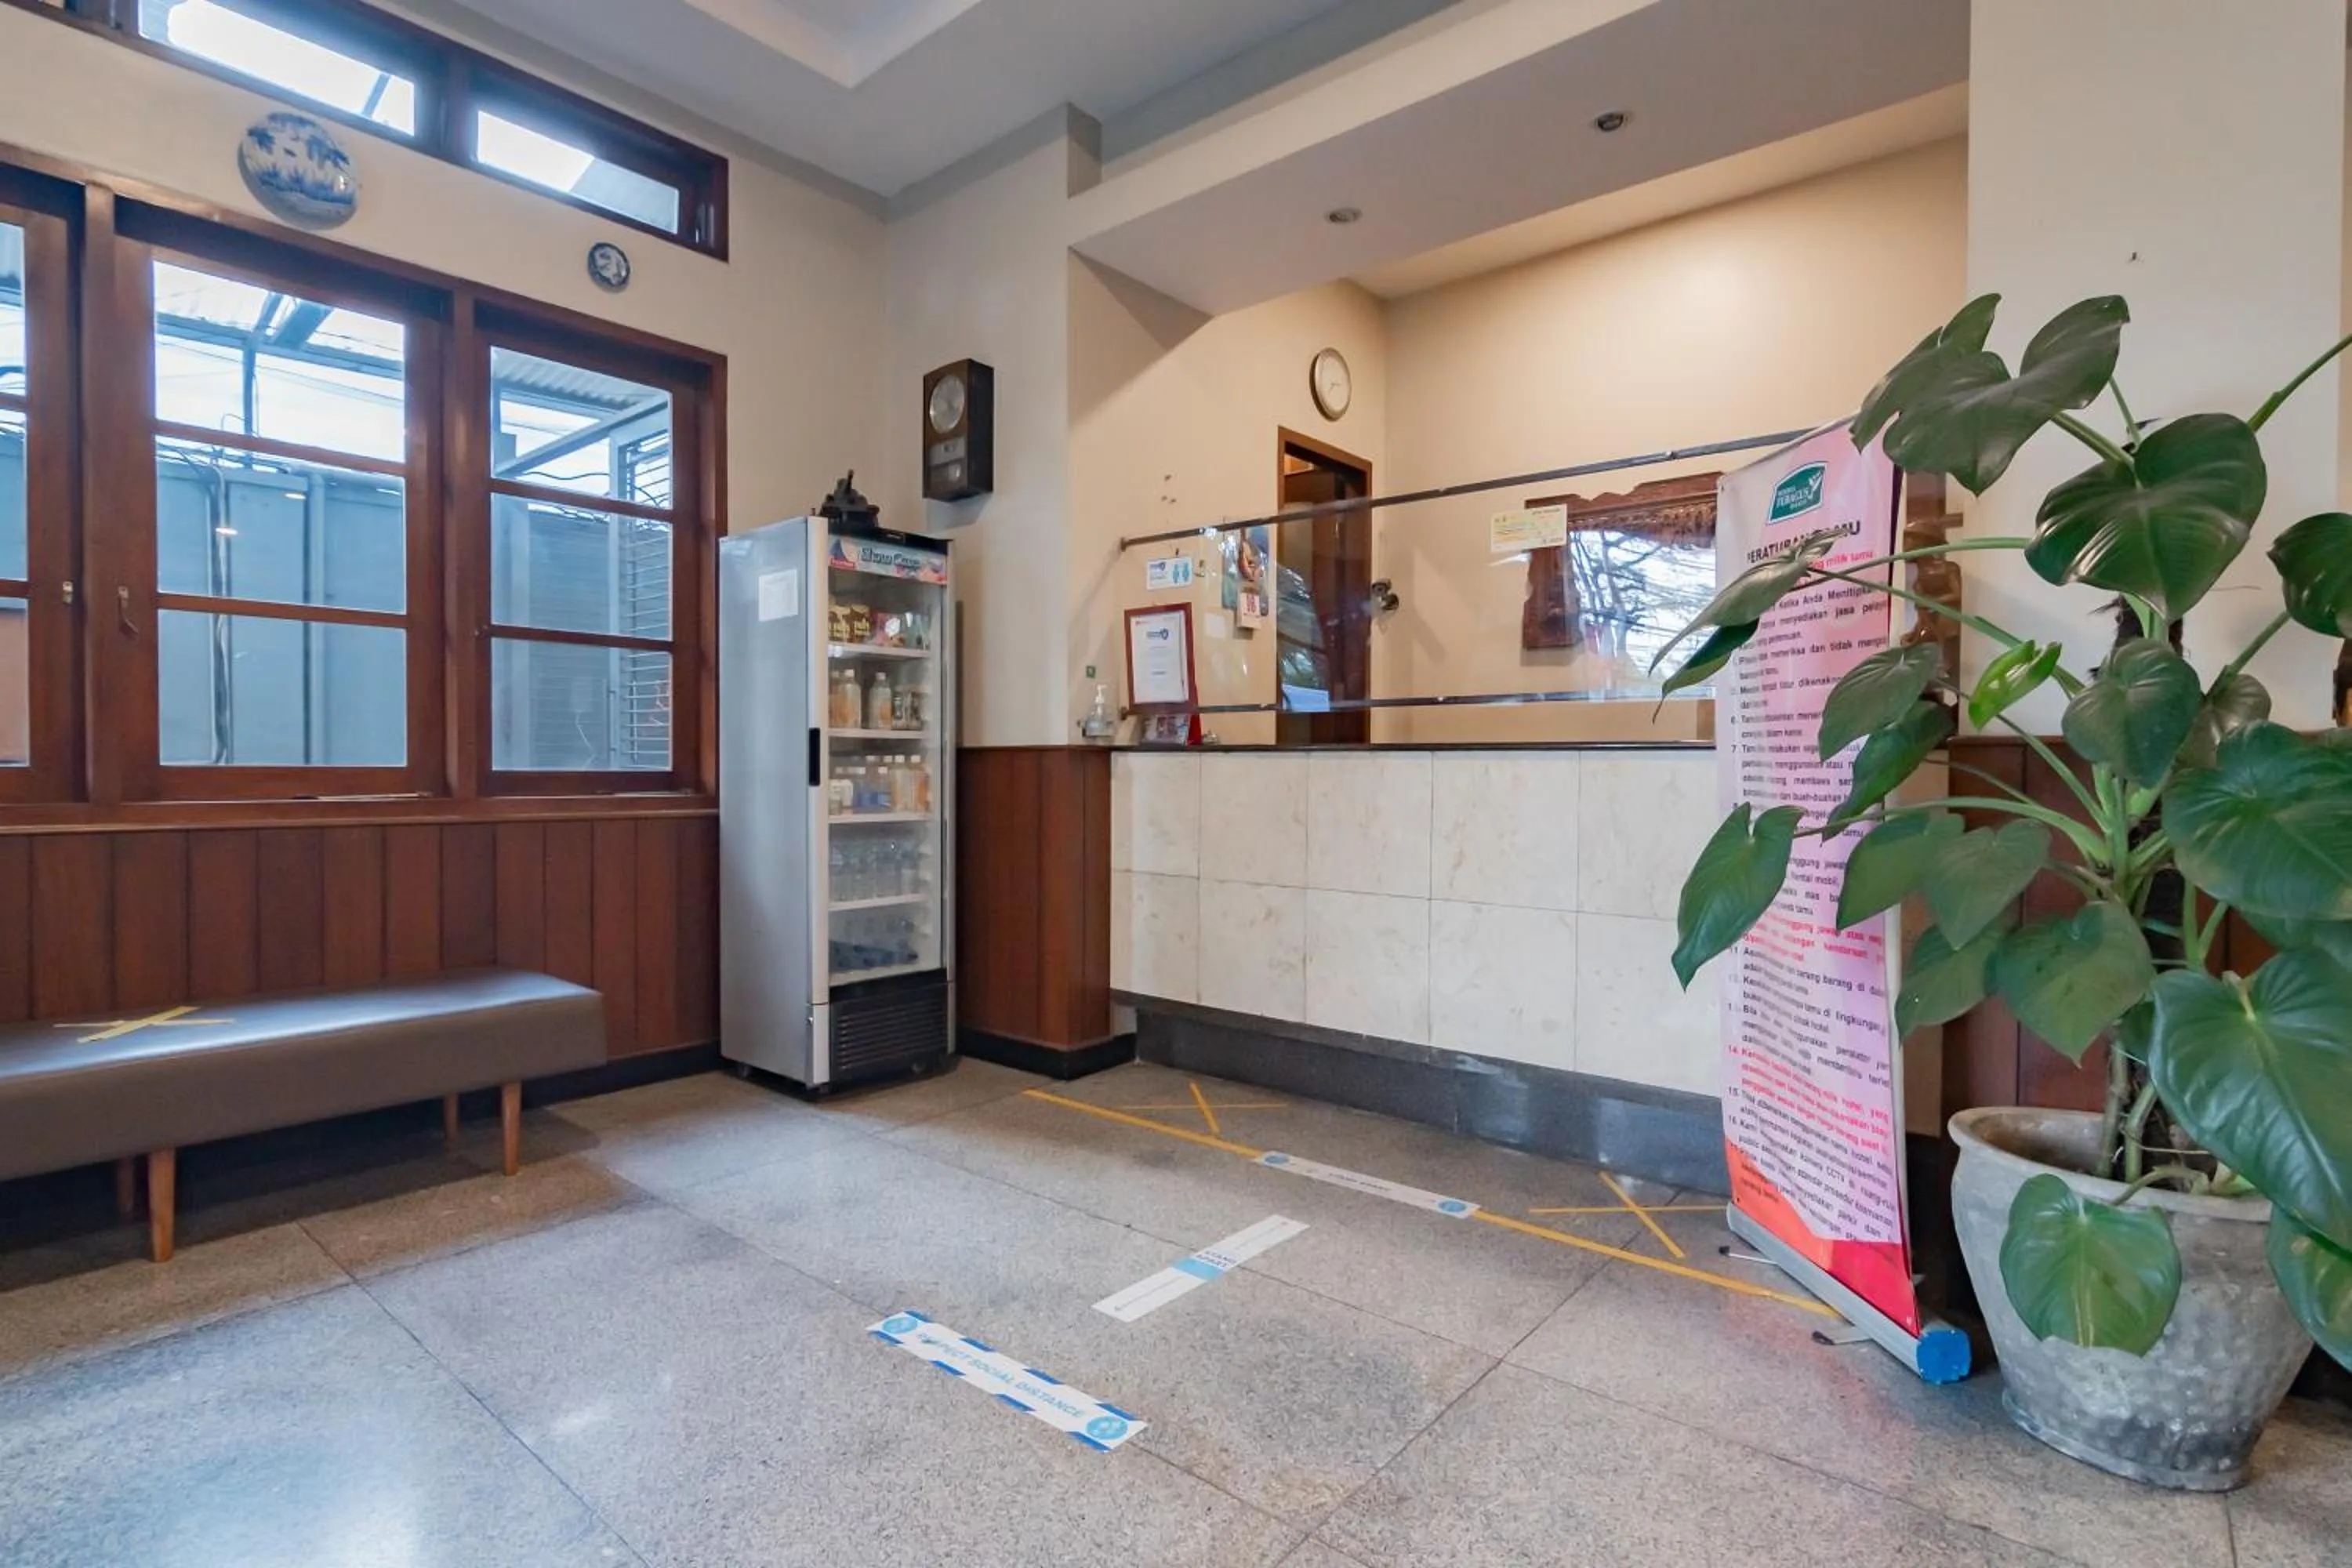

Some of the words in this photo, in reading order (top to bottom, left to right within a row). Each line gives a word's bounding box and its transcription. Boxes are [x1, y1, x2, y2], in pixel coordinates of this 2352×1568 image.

[1802, 594, 1822, 604] Anda
[1835, 607, 1853, 618] jasa
[1809, 644, 1824, 653] dan
